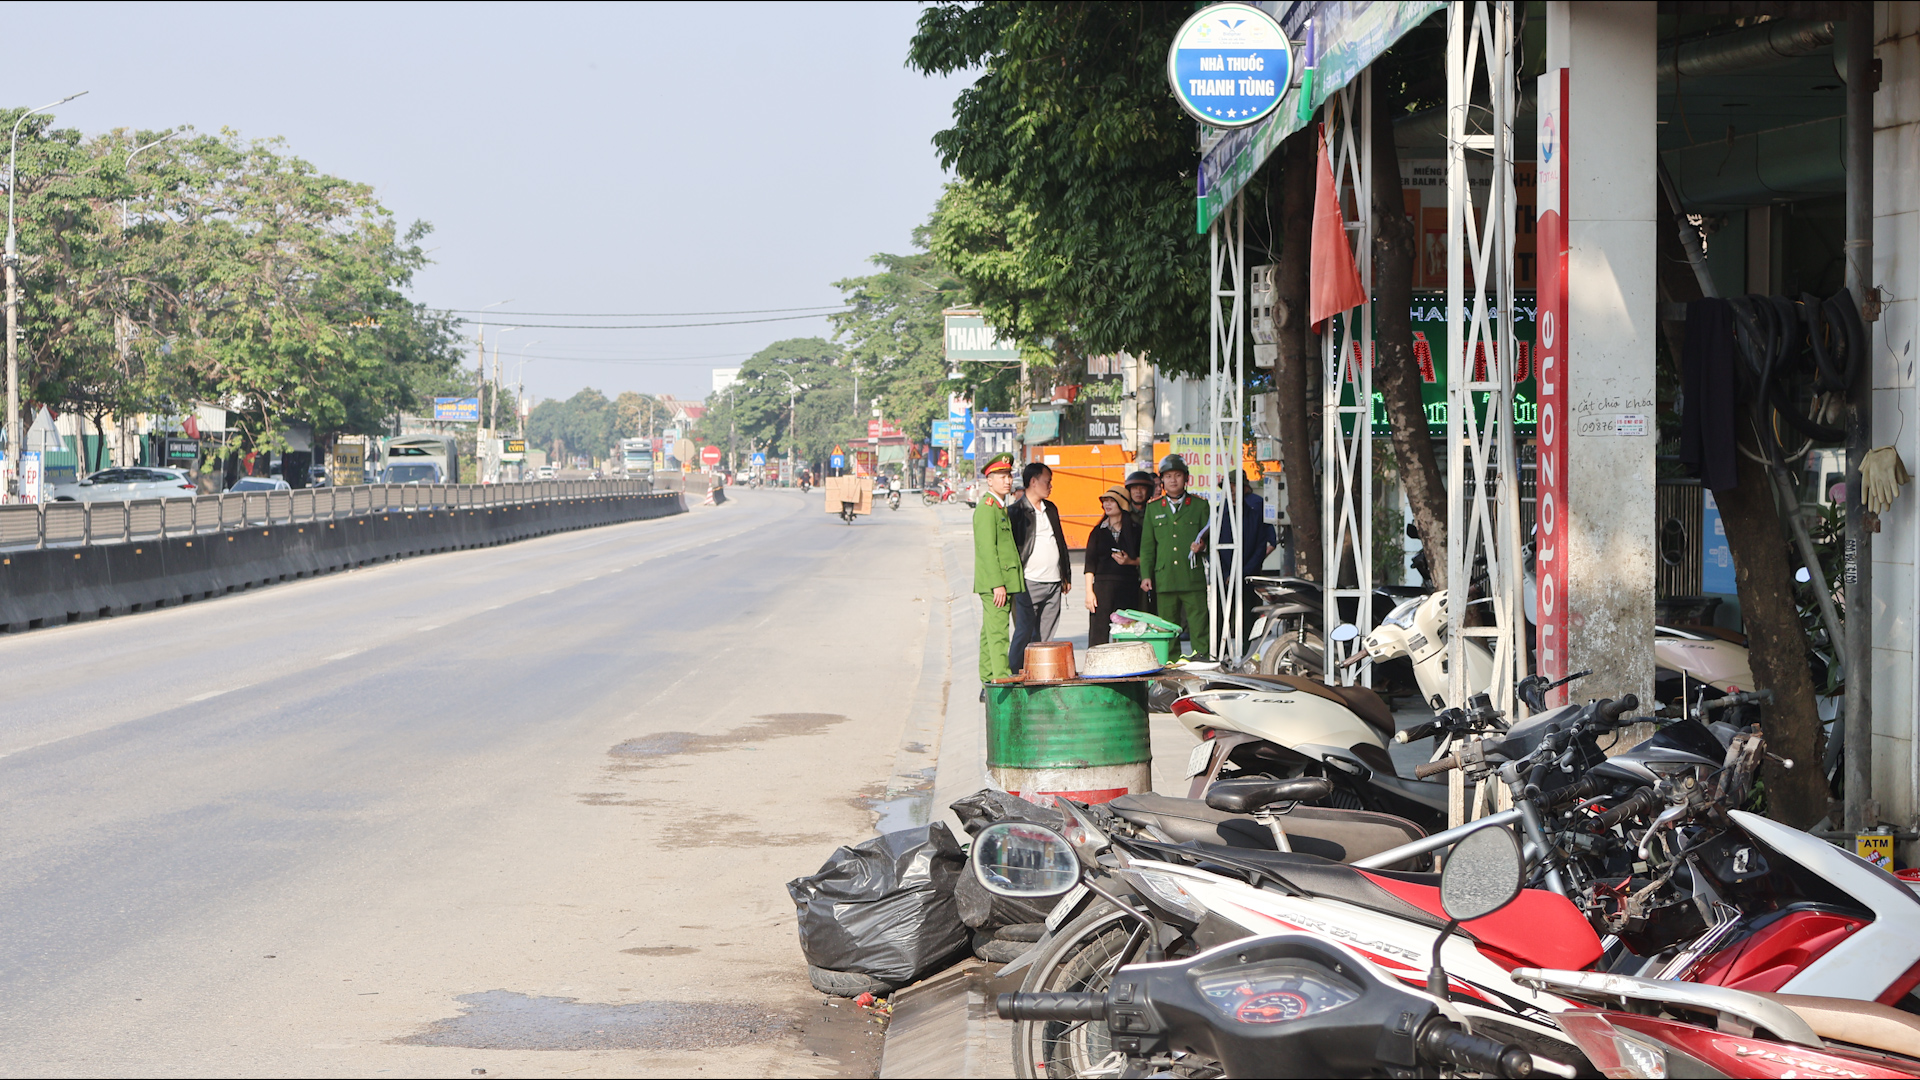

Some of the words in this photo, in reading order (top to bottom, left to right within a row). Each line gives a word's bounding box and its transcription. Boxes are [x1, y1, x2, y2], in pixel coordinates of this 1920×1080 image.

[1200, 54, 1224, 71] NHÀ
[1227, 53, 1264, 71] THUỐC
[1189, 80, 1235, 96] THANH
[1238, 76, 1275, 96] TÙNG
[1412, 178, 1436, 186] BALM
[1539, 170, 1559, 184] TOTAL
[1089, 419, 1107, 436] RỬA
[1108, 423, 1119, 436] XE
[1864, 839, 1888, 848] ATM
[1277, 911, 1326, 932] AIR
[1329, 926, 1422, 962] BLADE
[1732, 1043, 1868, 1079] VISION
